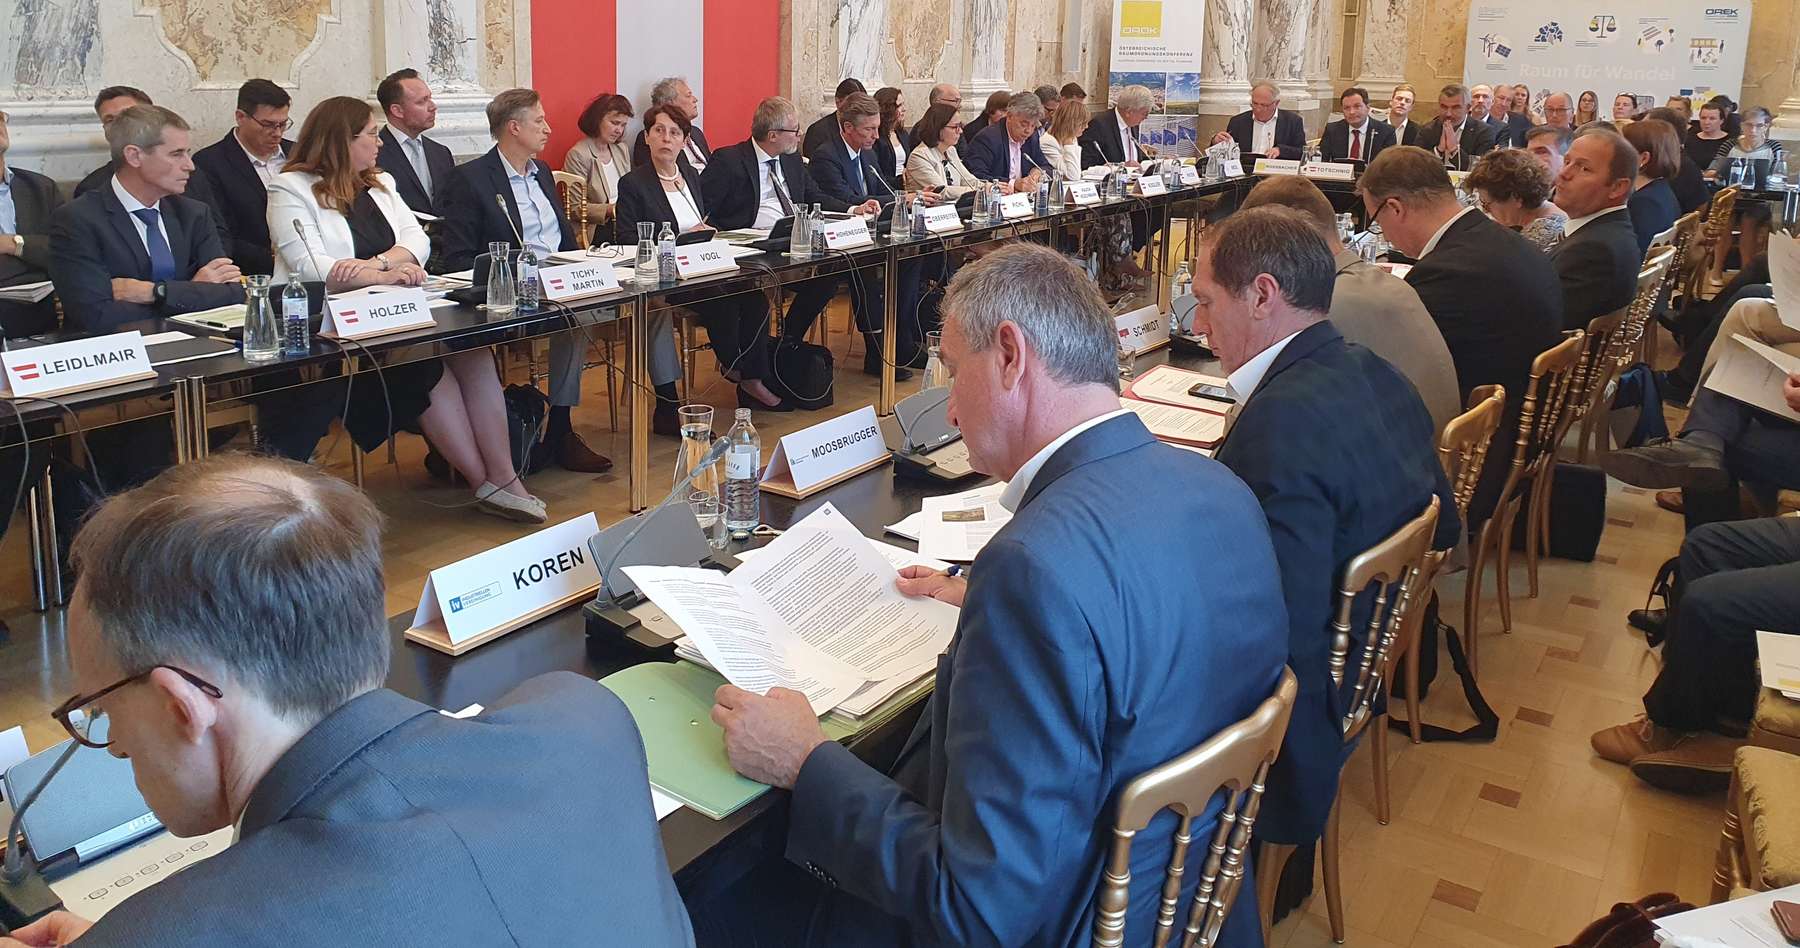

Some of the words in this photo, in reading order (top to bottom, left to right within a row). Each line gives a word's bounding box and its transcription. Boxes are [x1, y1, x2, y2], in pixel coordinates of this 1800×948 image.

[1520, 63, 1568, 78] Raum
[1575, 63, 1600, 79] für
[1606, 64, 1675, 80] Wandel
[700, 252, 721, 262] VOGL
[571, 267, 599, 279] TICHY-
[573, 279, 605, 291] MARTIN
[369, 302, 418, 319] HOLZER
[1133, 319, 1160, 337] SCHMIDT
[43, 348, 137, 375] LEIDLMAIR
[811, 425, 878, 459] MOOSBRUGGER
[512, 547, 585, 590] KOREN
